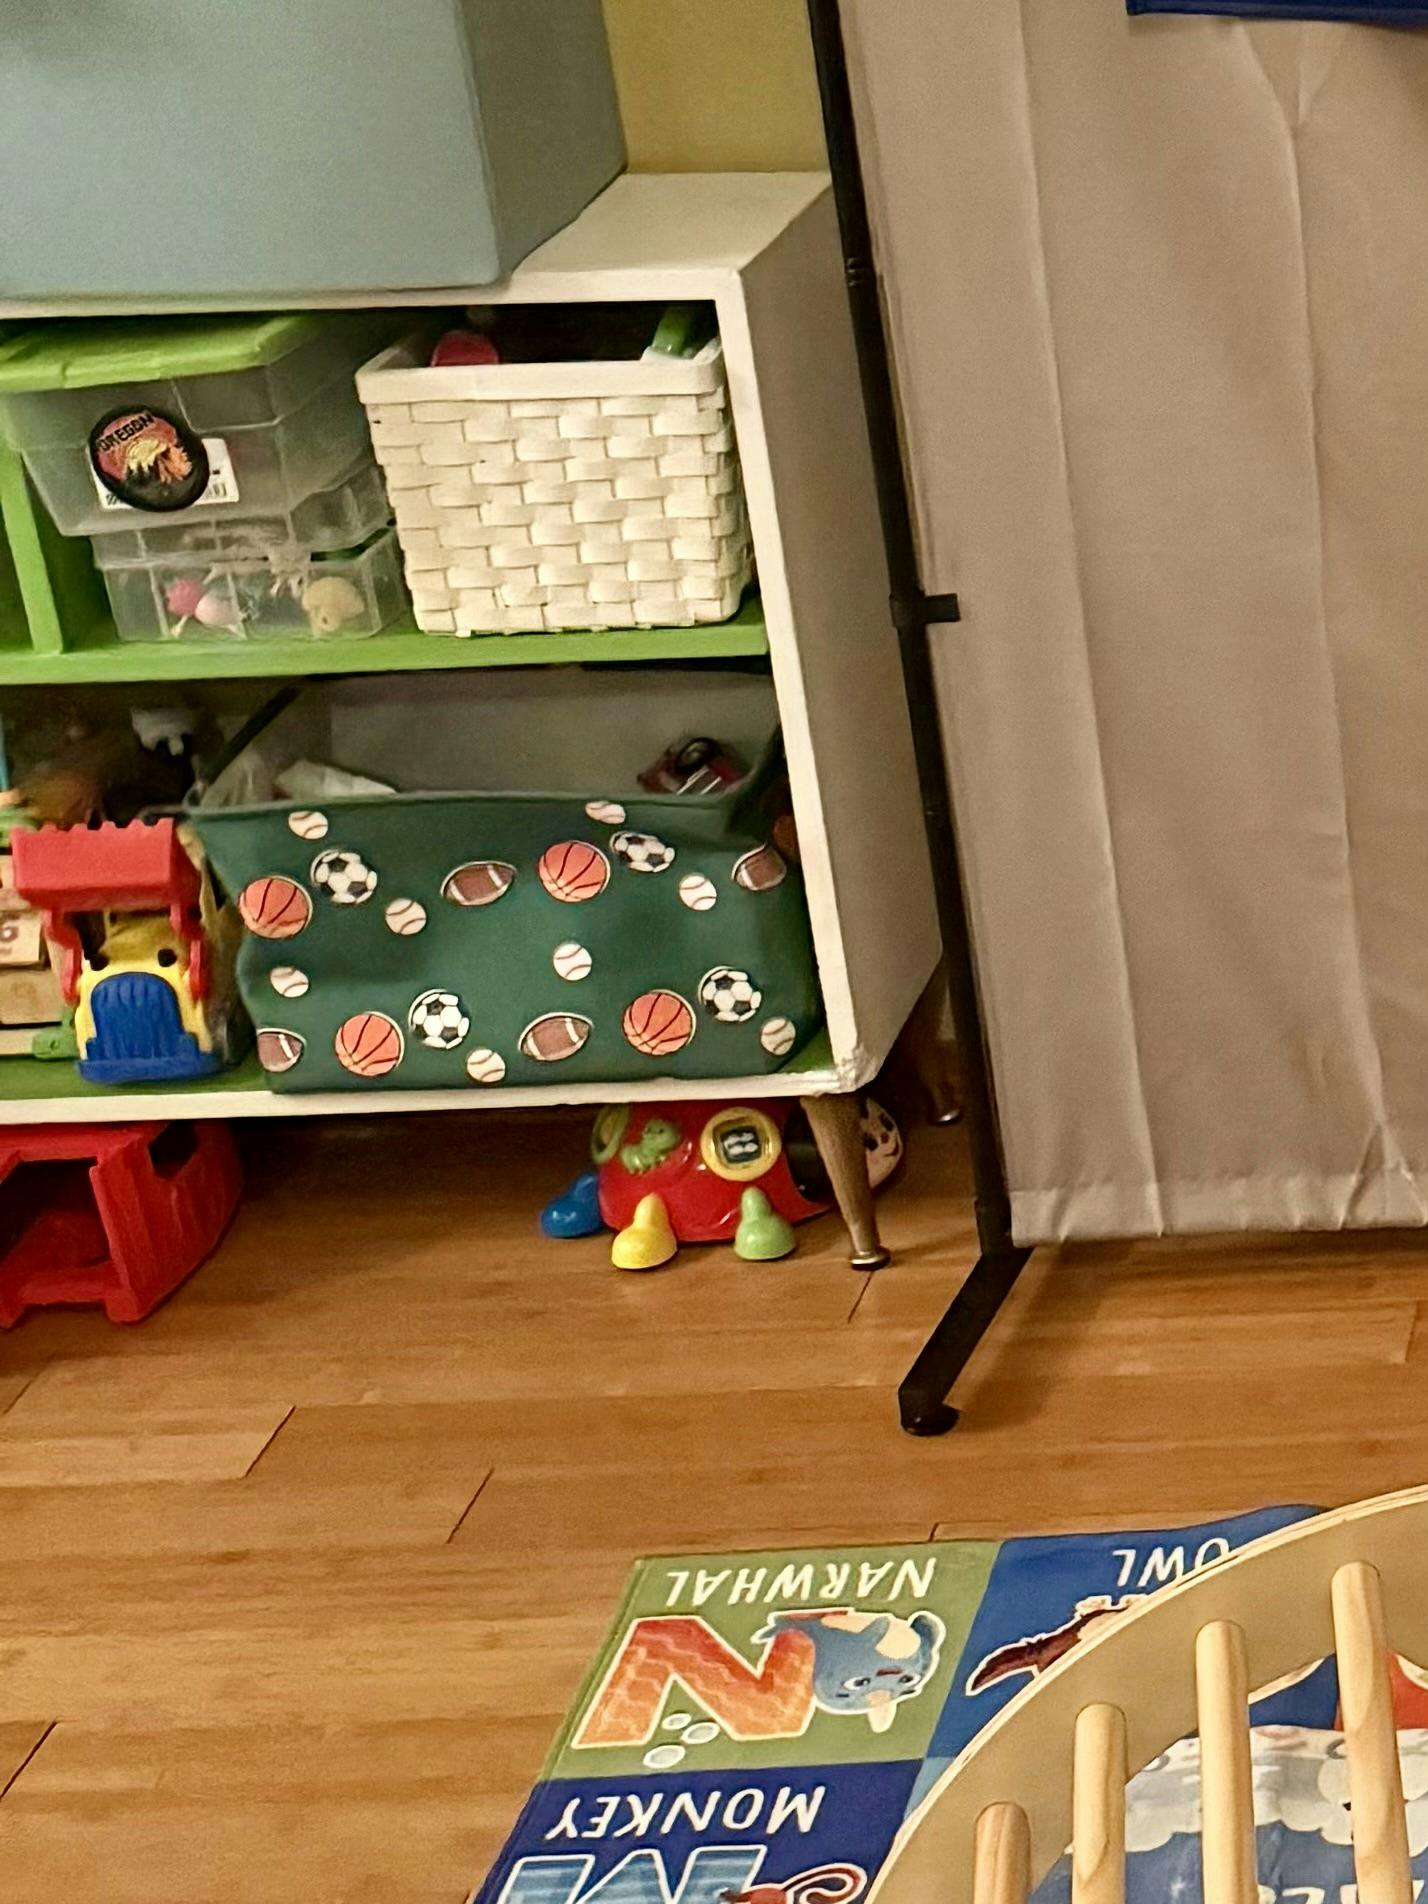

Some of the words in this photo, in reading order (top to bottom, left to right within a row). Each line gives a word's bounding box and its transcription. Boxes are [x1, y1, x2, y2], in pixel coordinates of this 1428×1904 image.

[97, 411, 157, 451] OREGON
[666, 1557, 936, 1606] NARWHAL
[544, 1784, 827, 1840] MONKEY
